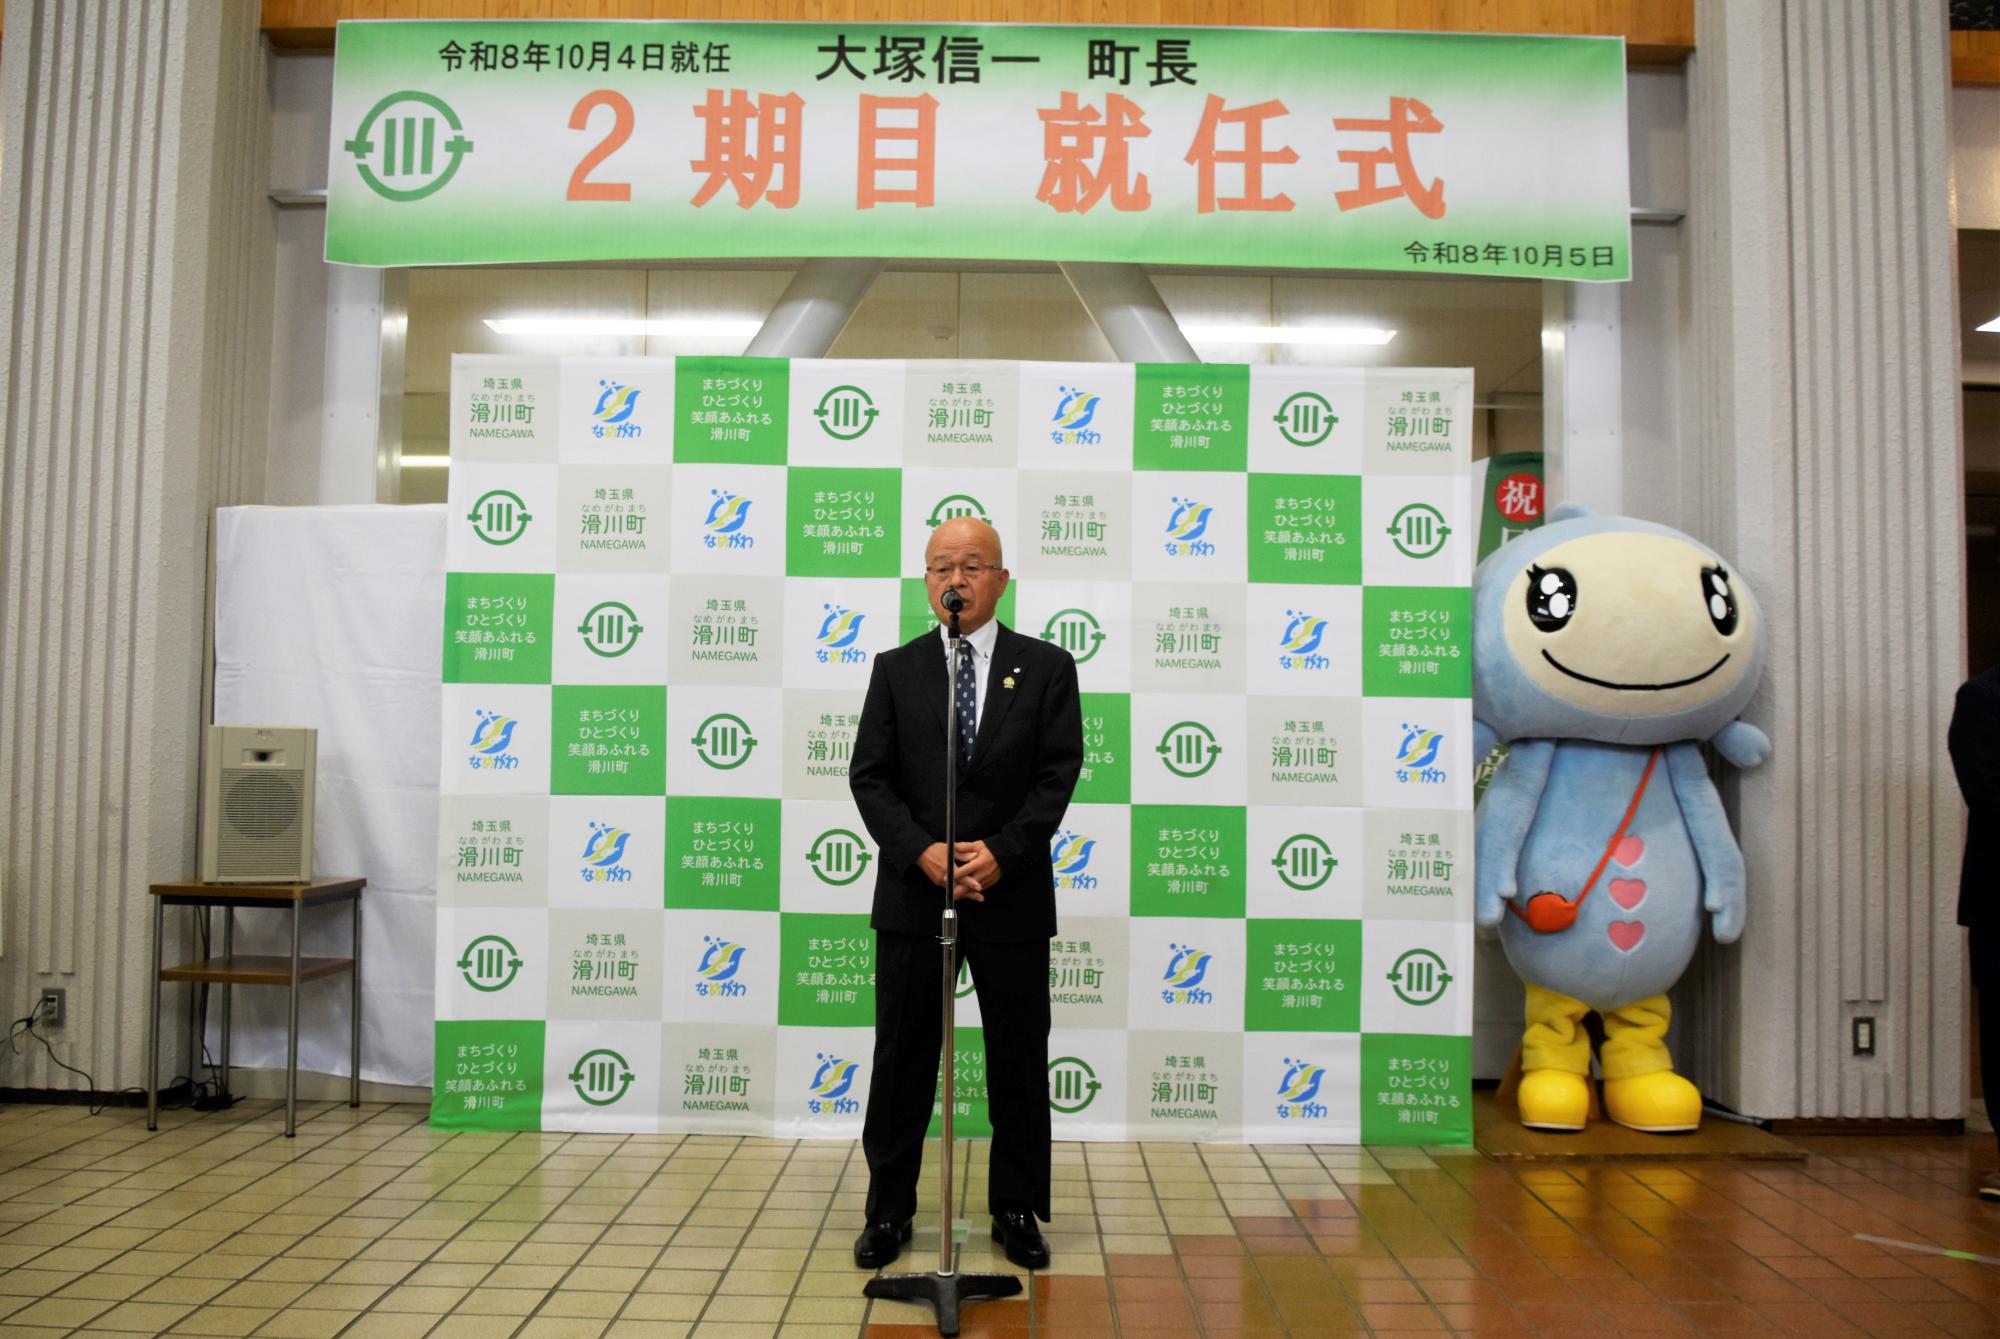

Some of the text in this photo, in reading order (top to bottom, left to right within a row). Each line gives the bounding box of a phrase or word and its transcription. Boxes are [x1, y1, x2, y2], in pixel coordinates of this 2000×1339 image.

[438, 34, 1198, 87] 令和8年10月4日就任 大塚信一 町長
[1035, 91, 1447, 220] 就任式
[1403, 240, 1615, 269] 令和8年10月5日
[484, 378, 522, 389] 埼玉県
[703, 378, 762, 391] まちづくり
[943, 383, 981, 393] 埼玉県
[1163, 386, 1222, 398] まちづくり
[1402, 392, 1440, 402] 埼玉県
[702, 395, 762, 408] ひとづくり
[471, 403, 534, 423] 滑川町
[1162, 402, 1223, 415] ひとづくり
[692, 411, 772, 425] 笑顔あふれる
[929, 408, 994, 428] 滑川町
[592, 422, 641, 438] なめがわ
[1151, 418, 1231, 432] 笑顔あふれる
[1388, 417, 1452, 436] 滑川町
[470, 429, 534, 438] NAMEGAWA
[711, 427, 751, 441] 滑川町
[928, 434, 992, 442] NAMEGAWA
[1051, 428, 1102, 444] なめがわ
[1171, 435, 1210, 448] 滑川町
[1387, 442, 1451, 451] NAMEGAWA
[595, 489, 633, 500] 埼玉県
[815, 491, 874, 504] まちづくり
[1055, 496, 1093, 506] 埼玉県
[1501, 480, 1538, 515] 祝
[1501, 480, 1538, 515] 祝
[1501, 480, 1538, 515] 祝
[1501, 480, 1538, 515] 祝
[1275, 497, 1335, 510] まちづくり
[814, 507, 875, 521] ひとづくり
[1275, 514, 1335, 527] ひとづくり
[582, 514, 646, 534] 滑川町
[804, 524, 884, 538] 笑顔あふれる
[1042, 521, 1106, 541] 滑川町
[1265, 530, 1345, 545] 笑顔あふれる
[581, 540, 645, 549] NAMEGAWA
[704, 534, 753, 548] なめがわ
[823, 541, 864, 554] 滑川町
[1042, 547, 1106, 555] NAMEGAWA
[1165, 540, 1215, 556] なめがわ
[1285, 548, 1324, 561] 滑川町
[467, 596, 527, 610] まちづくり
[707, 600, 745, 611] 埼玉県
[1170, 608, 1208, 618] 埼玉県
[1390, 610, 1449, 623] まちづくり
[466, 614, 526, 627] ひとづくり
[457, 630, 536, 643] 笑顔あふれる
[693, 625, 758, 646] 滑川町
[1390, 627, 1450, 640] ひとづくり
[1156, 633, 1221, 653] 滑川町
[475, 647, 514, 660] 滑川町
[692, 651, 757, 661] NAMEGAWA
[816, 646, 866, 663] なめがわ
[1380, 644, 1461, 656] 笑顔あふれる
[1156, 659, 1220, 668] NAMEGAWA
[1280, 653, 1329, 669] なめがわ
[1399, 661, 1439, 673] 滑川町
[579, 709, 639, 722] まちづくり
[579, 726, 640, 739] ひとづくり
[1285, 721, 1323, 732] 埼玉県
[568, 743, 650, 756] 笑顔あふれる
[807, 740, 856, 761] 滑川
[469, 753, 518, 769] なめがわ
[1272, 747, 1337, 767] 滑川町
[588, 760, 628, 773] 滑川町
[806, 766, 849, 776] NAMEG
[1272, 773, 1337, 782] NAMEGAWA
[1396, 767, 1446, 783] なめがわ
[472, 821, 511, 832] 埼玉県
[693, 821, 753, 835] まちづくり
[1159, 828, 1219, 842] まちづくり
[1401, 834, 1439, 845] 埼玉県
[692, 839, 754, 852] ひとづくり
[458, 847, 523, 867] 滑川町
[1158, 846, 1220, 859] ひとづくり
[681, 855, 764, 870] 笑顔あふれる
[581, 867, 631, 882] なめがわ
[1148, 862, 1230, 877] 笑顔あふれる
[1388, 860, 1453, 881] 滑川町
[458, 873, 523, 881] NAMEGAWA
[702, 872, 742, 886] 滑川町
[1168, 880, 1207, 893] 滑川町
[1388, 886, 1452, 895] NAMEGAWA
[586, 934, 625, 945] 埼玉県
[809, 938, 869, 951] まちづくり
[1051, 941, 1091, 953] 埼玉県
[1274, 943, 1335, 956] まちづくり
[808, 955, 869, 968] ひとづくり
[1274, 960, 1335, 973] ひとづくり
[573, 960, 638, 980] 滑川町
[696, 980, 748, 996] なめがわ
[1263, 977, 1345, 991] 笑顔あふれる
[572, 986, 637, 996] NAMEGAWA
[816, 989, 857, 1003] 滑川町
[1162, 987, 1212, 1004] なめがわ
[1050, 994, 1103, 1004] MEGAWA
[1283, 995, 1322, 1007] 滑川町
[458, 1045, 517, 1057] まちづくり
[699, 1049, 737, 1060] 埼玉県
[1166, 1056, 1204, 1067] 埼玉県
[1389, 1058, 1449, 1072] まちづくり
[457, 1062, 517, 1075] ひとづくり
[446, 1079, 526, 1092] 笑顔あふれる
[684, 1075, 750, 1096] 滑川町
[1388, 1076, 1449, 1089] ひとづくり
[1152, 1082, 1217, 1104] 滑川町
[1379, 1092, 1459, 1107] 笑顔あふれる
[464, 1095, 504, 1109] 滑川町
[683, 1101, 750, 1110] NAMEGAWA
[808, 1096, 859, 1114] なめがわ
[1152, 1109, 1217, 1118] NAMEGAWA
[1277, 1103, 1327, 1120] なめがわ
[1397, 1109, 1439, 1124] 滑川町
